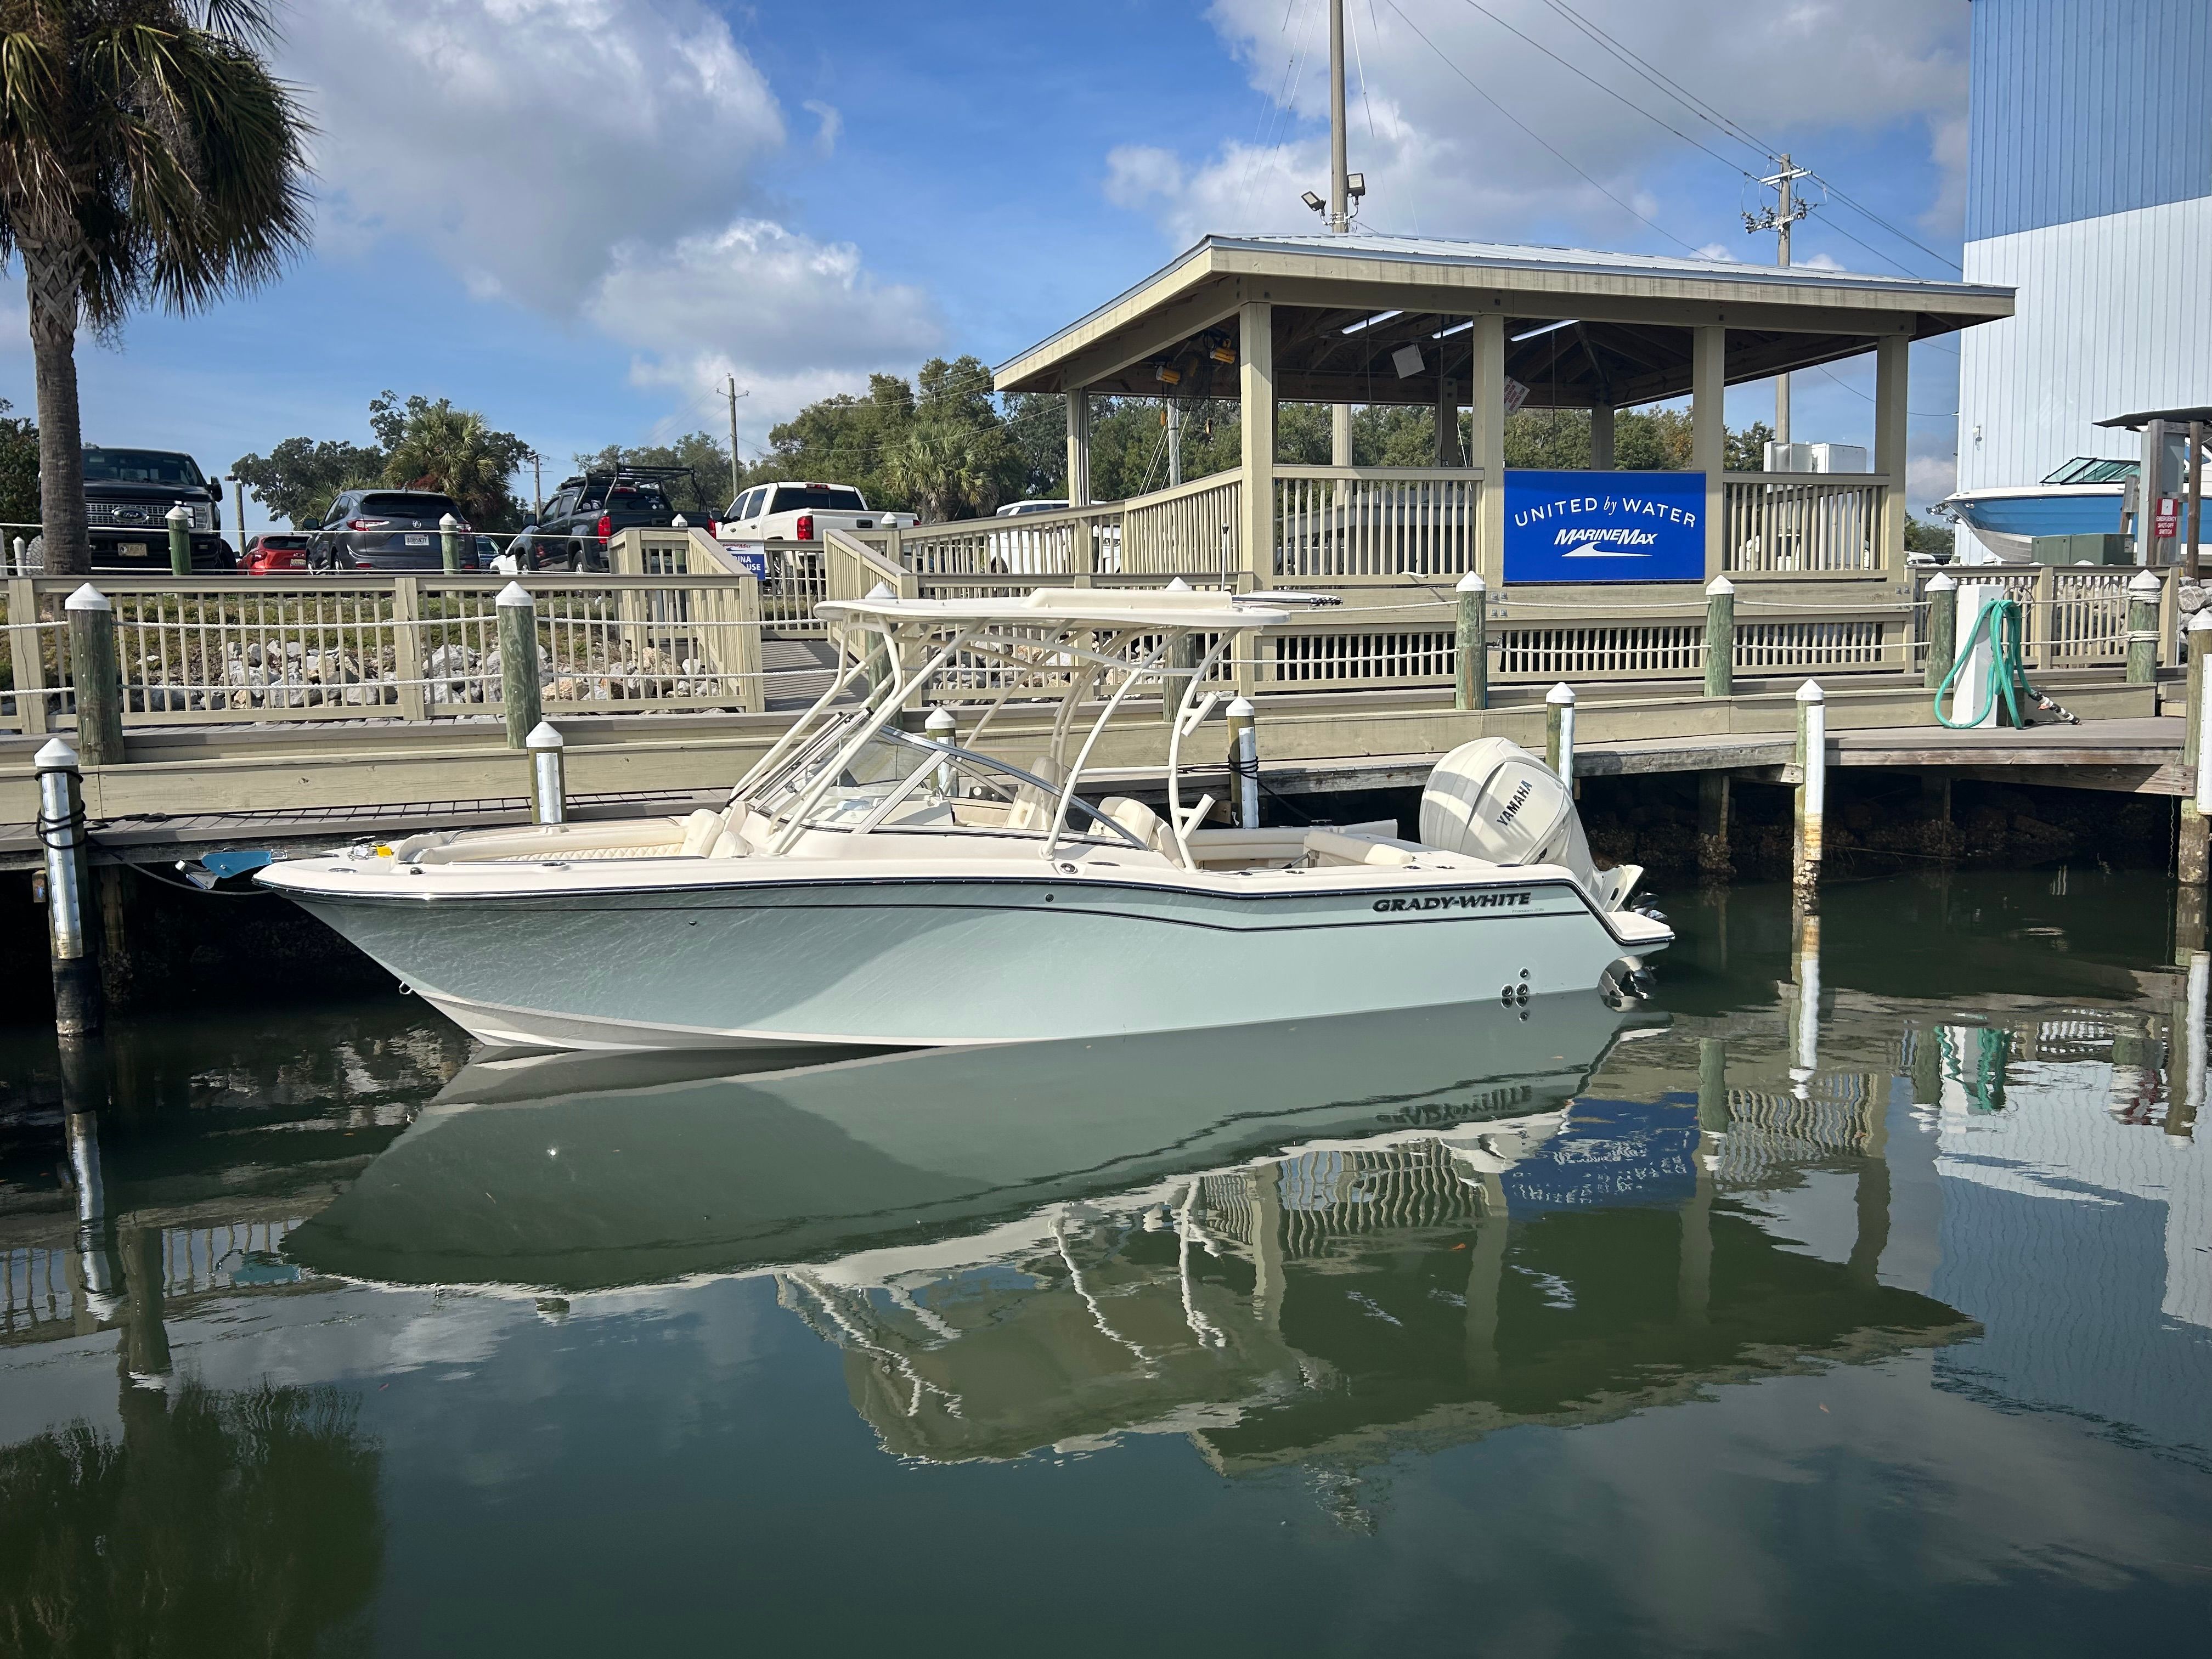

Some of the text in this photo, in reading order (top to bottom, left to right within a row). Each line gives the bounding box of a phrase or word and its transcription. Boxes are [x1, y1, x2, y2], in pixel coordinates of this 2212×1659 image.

[1515, 496, 1696, 528] UNITED by WATER
[1554, 529, 1658, 545] MARINEMAX
[1497, 780, 1532, 826] YAMAHA
[1373, 892, 1531, 912] GRADY-WHITE
